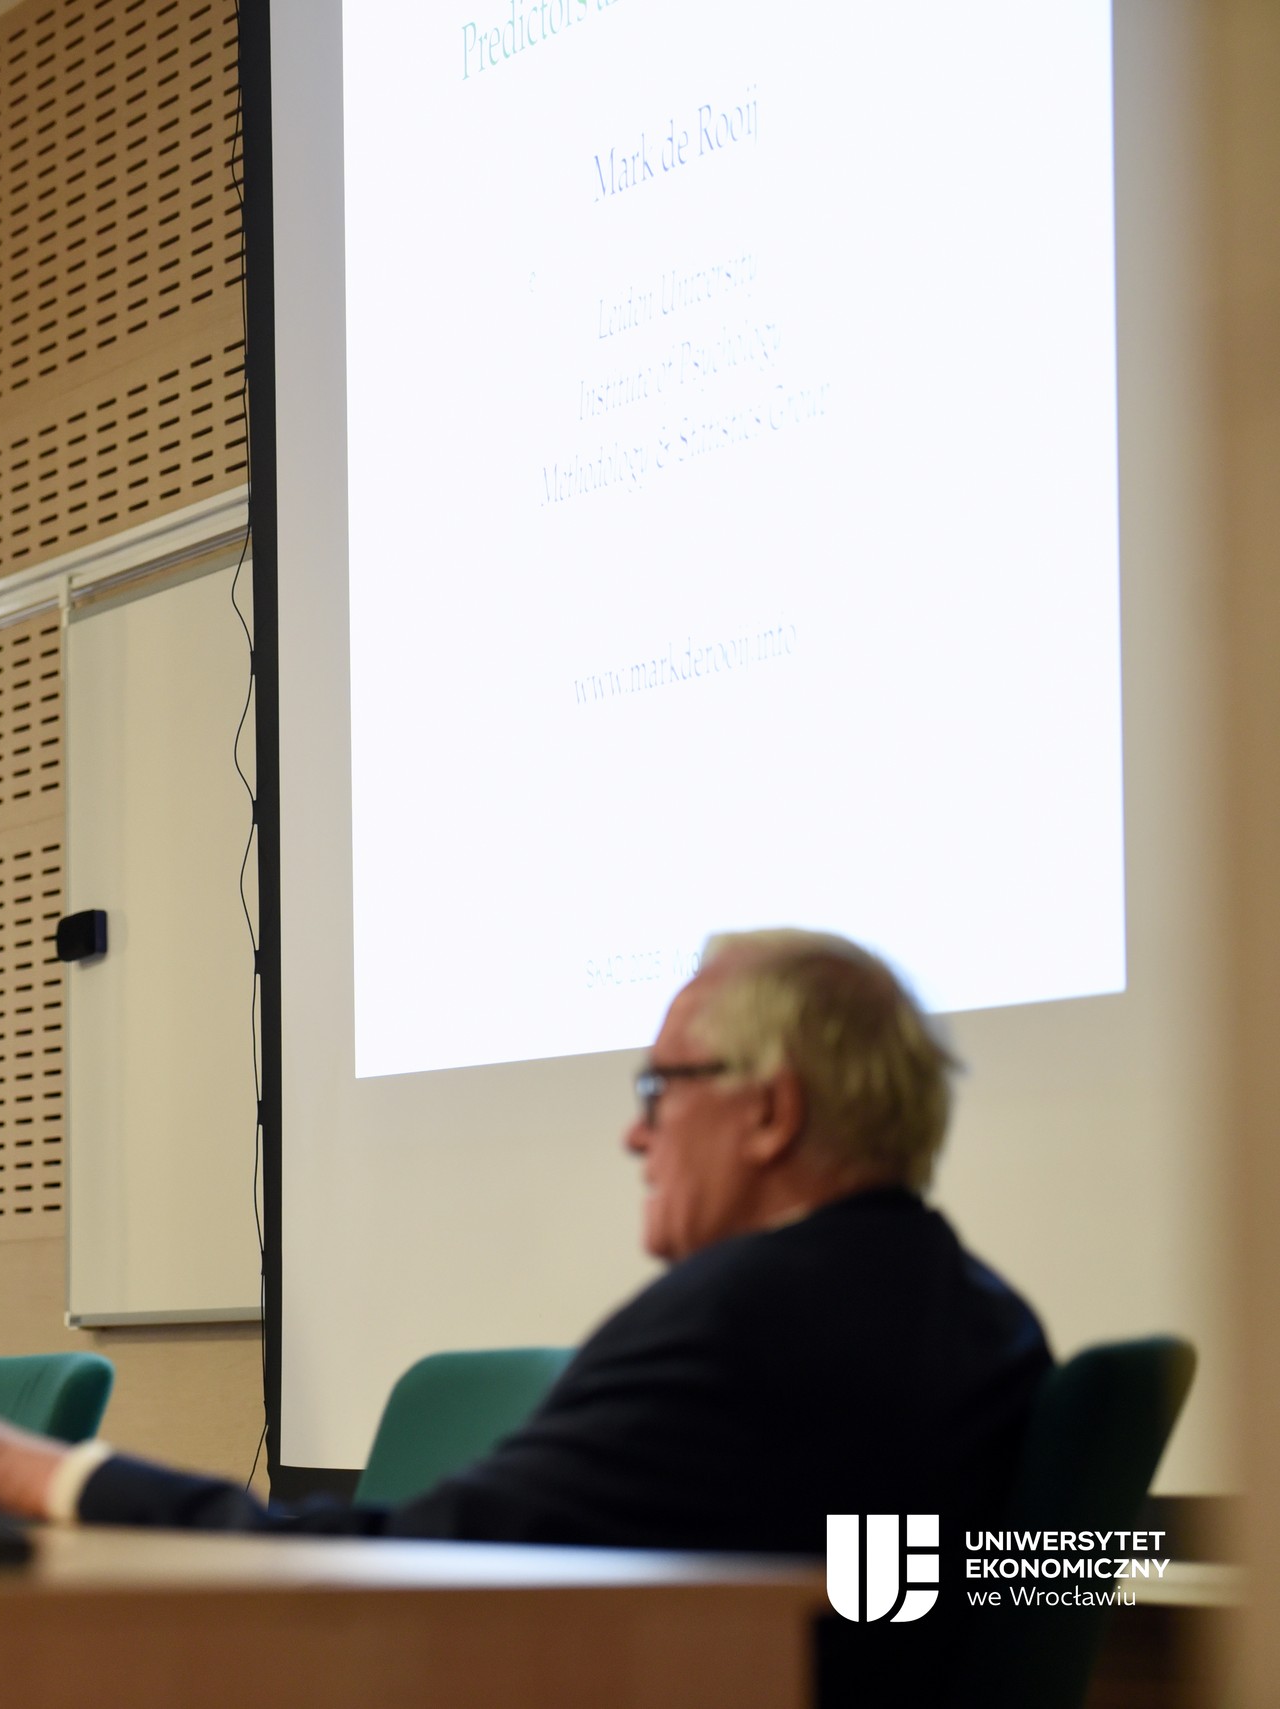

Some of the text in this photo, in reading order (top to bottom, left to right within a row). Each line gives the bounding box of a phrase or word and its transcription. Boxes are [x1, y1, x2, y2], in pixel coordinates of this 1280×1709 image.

[462, 0, 588, 80] Predictors
[592, 83, 758, 203] Mark de Rooij
